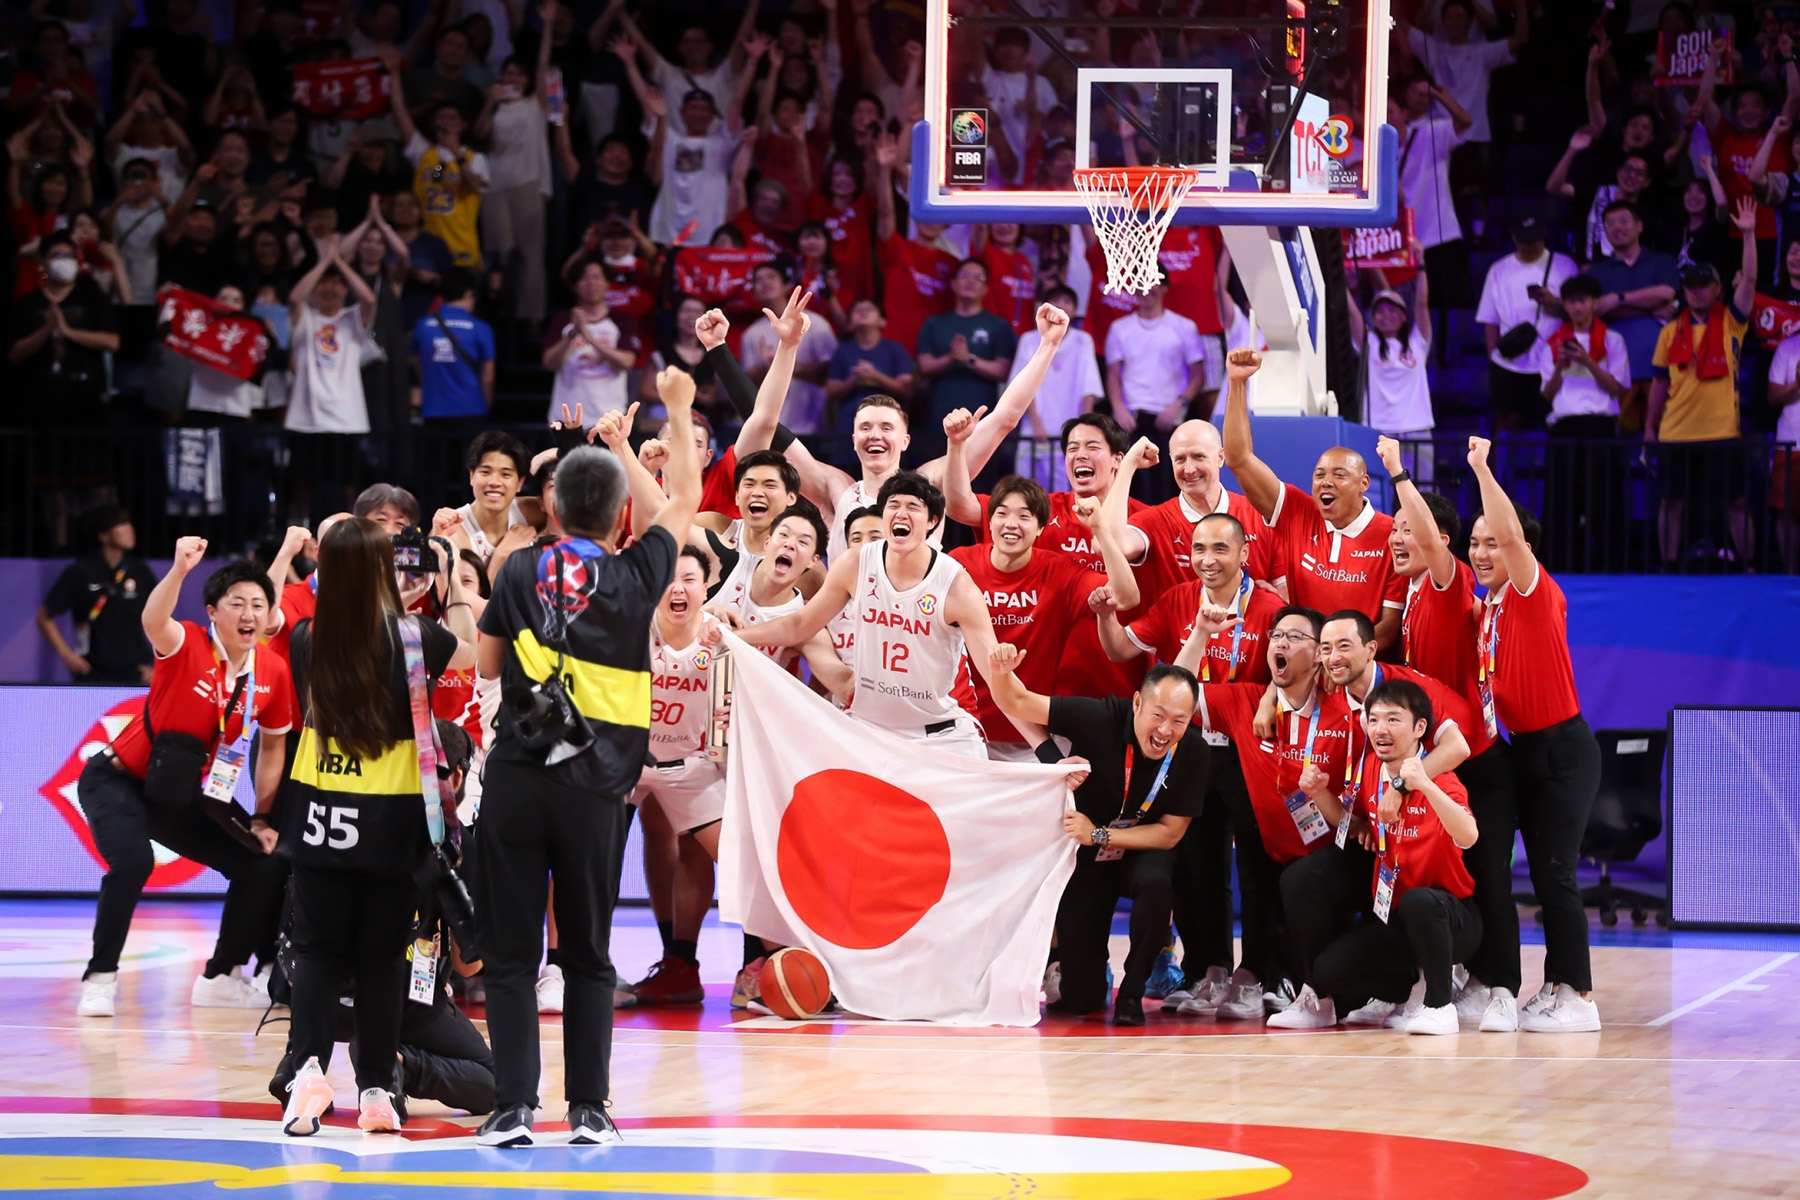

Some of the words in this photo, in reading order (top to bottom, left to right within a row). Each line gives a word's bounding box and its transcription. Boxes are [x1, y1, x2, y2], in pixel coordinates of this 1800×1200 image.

[1668, 53, 1720, 77] Japa
[955, 152, 981, 165] FIBA
[1340, 175, 1358, 183] CUP
[1346, 229, 1402, 259] Japan
[1350, 550, 1384, 558] JAPAN
[1315, 563, 1367, 583] SoftBank
[983, 590, 1038, 608] APAN
[862, 608, 931, 636] JAPAN
[990, 613, 1034, 626] oftBank
[1227, 630, 1259, 642] JPAN
[882, 641, 909, 673] 12
[1204, 645, 1247, 663] oftBak
[242, 683, 271, 693] JPAN
[651, 671, 708, 692] APAN
[877, 681, 933, 701] SoftBank
[303, 801, 359, 850] 55
